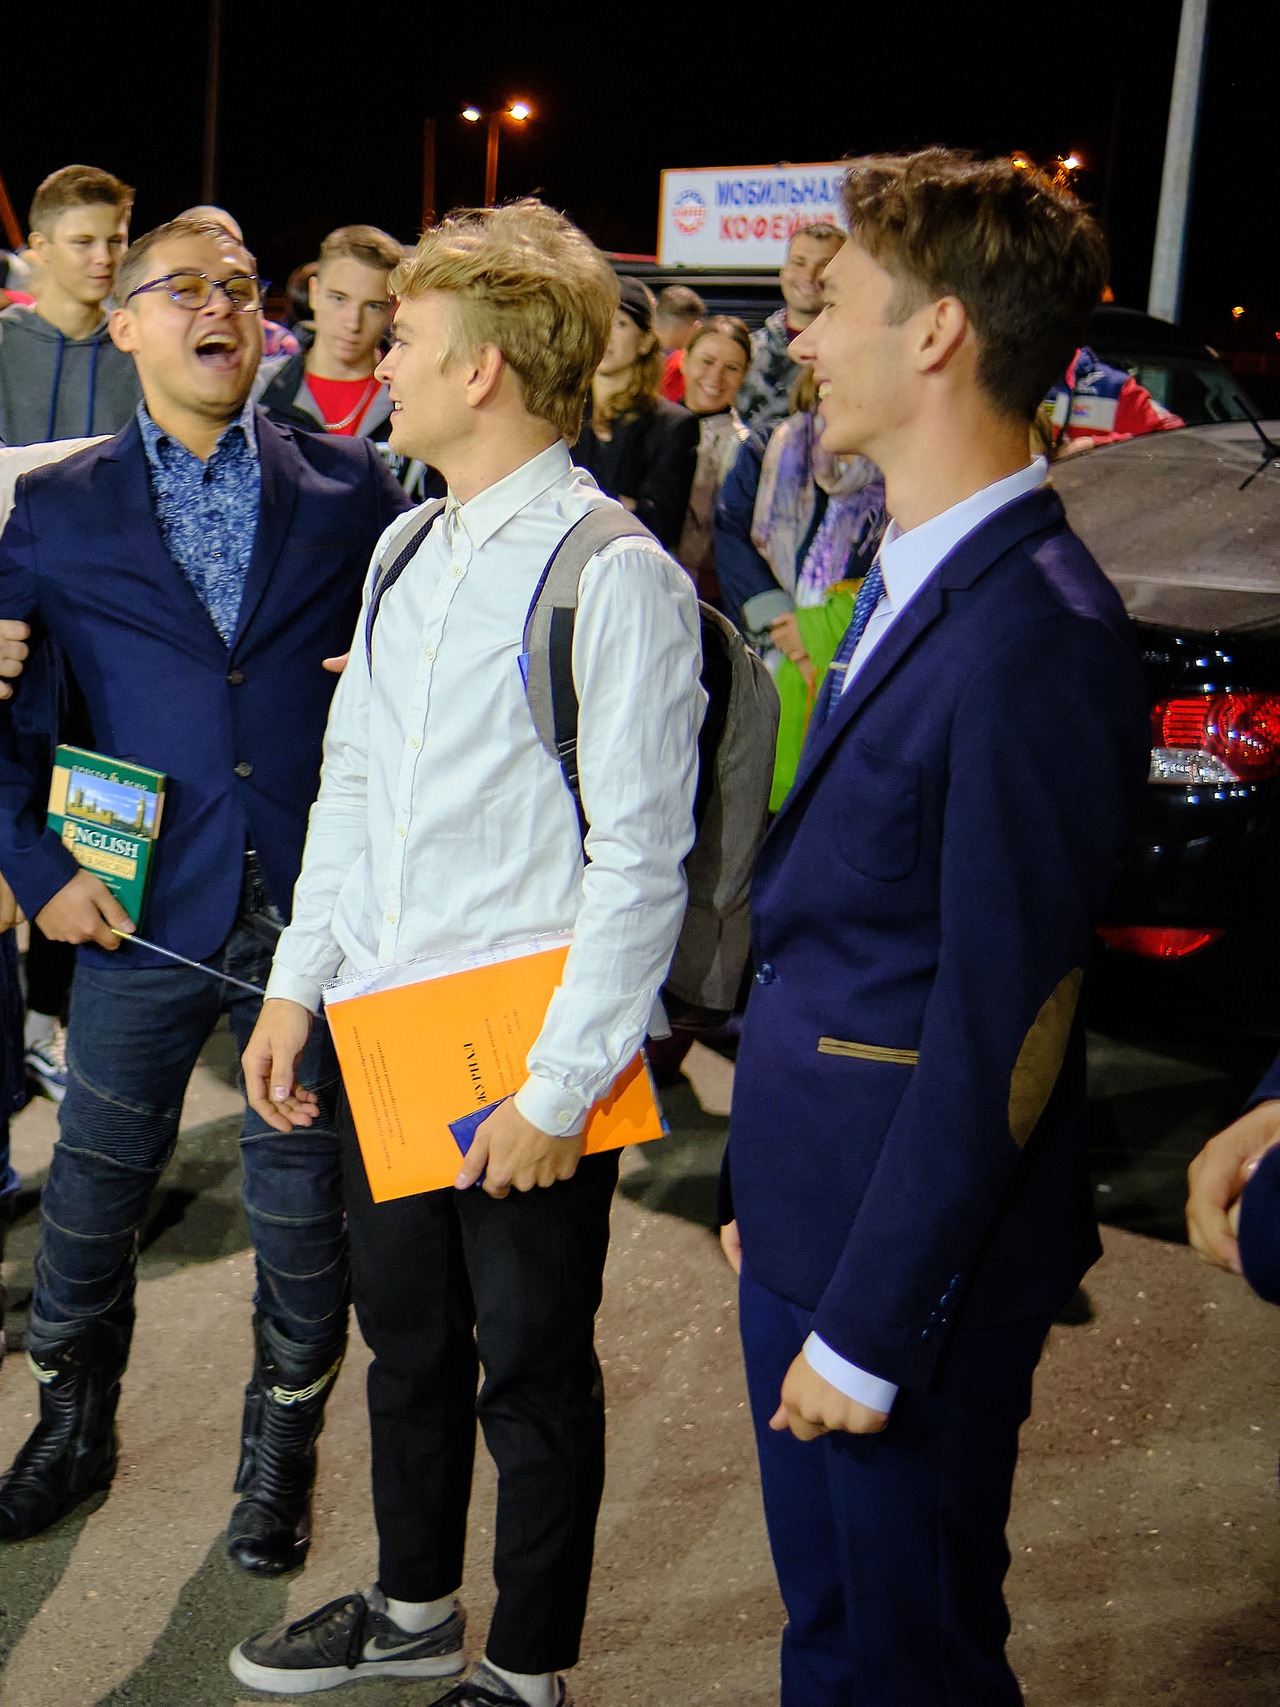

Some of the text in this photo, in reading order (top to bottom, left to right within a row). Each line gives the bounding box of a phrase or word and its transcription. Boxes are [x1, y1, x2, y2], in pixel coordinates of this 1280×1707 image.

[715, 178, 842, 206] МОБИЛЬНАЯ
[64, 822, 140, 858] ENGLISH
[463, 1042, 488, 1106] ЖУРНАЛ
